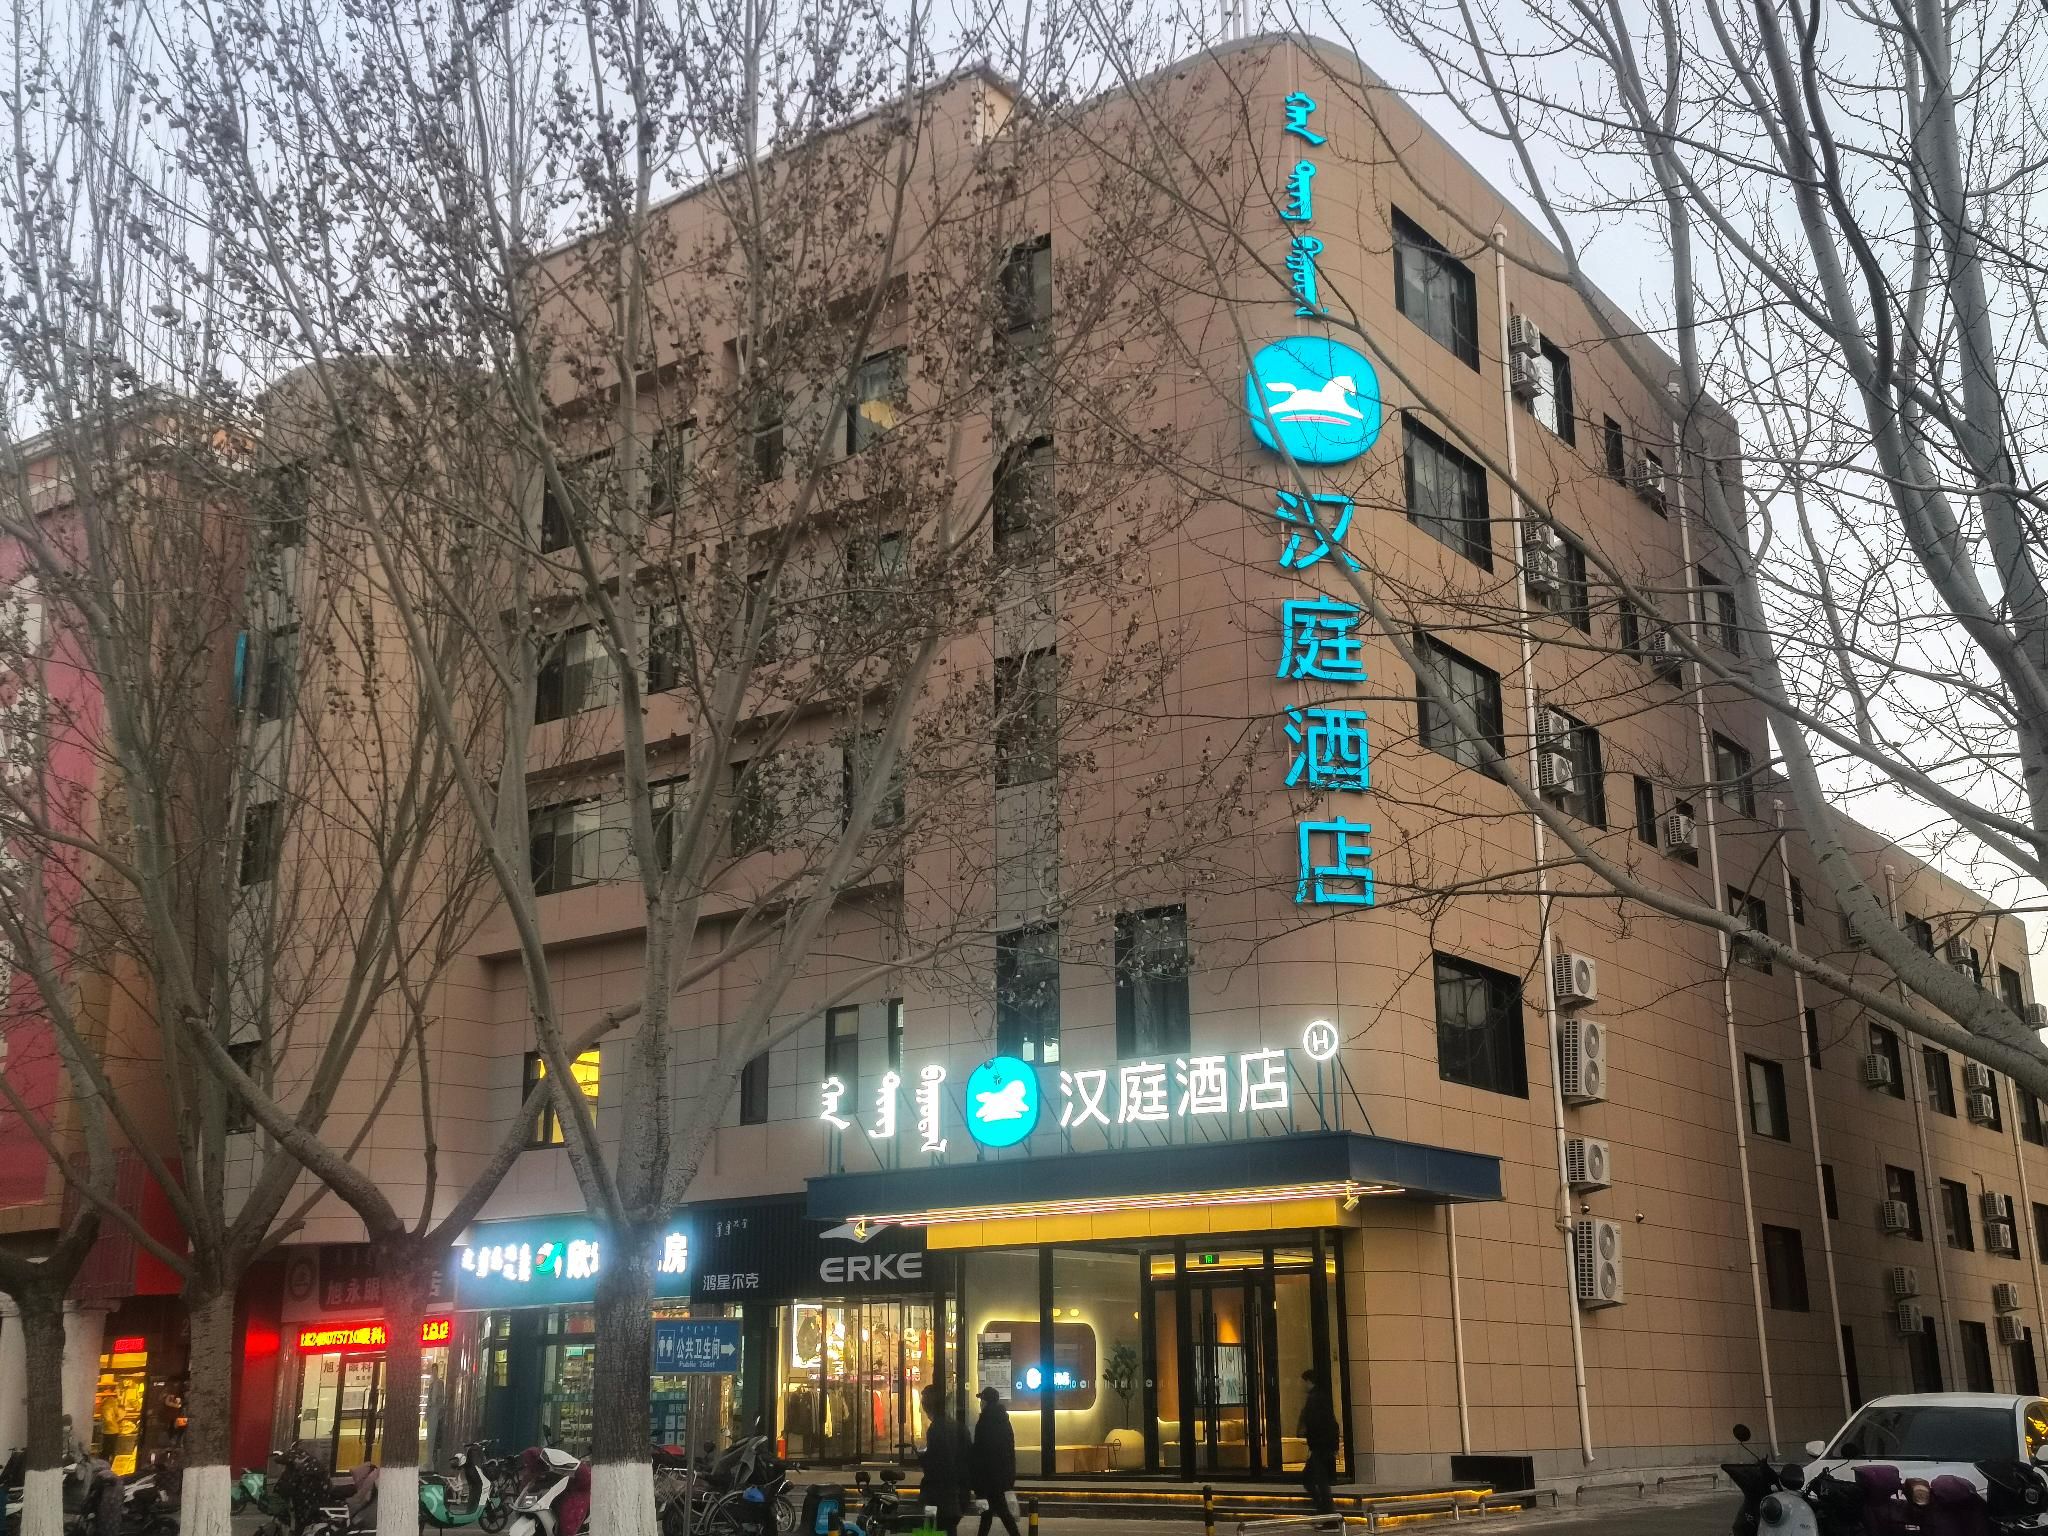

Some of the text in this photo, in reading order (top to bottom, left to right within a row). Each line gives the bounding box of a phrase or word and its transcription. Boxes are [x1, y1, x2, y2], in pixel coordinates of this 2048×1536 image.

[1276, 489, 1376, 909] 汉庭酒店
[1057, 1047, 1291, 1129] 汉庭酒店
[819, 1252, 924, 1283] ERKE
[702, 1272, 760, 1291] 鸿星尔克
[676, 1336, 721, 1360] 公共卫生间
[679, 1360, 716, 1368] Public Toilet
